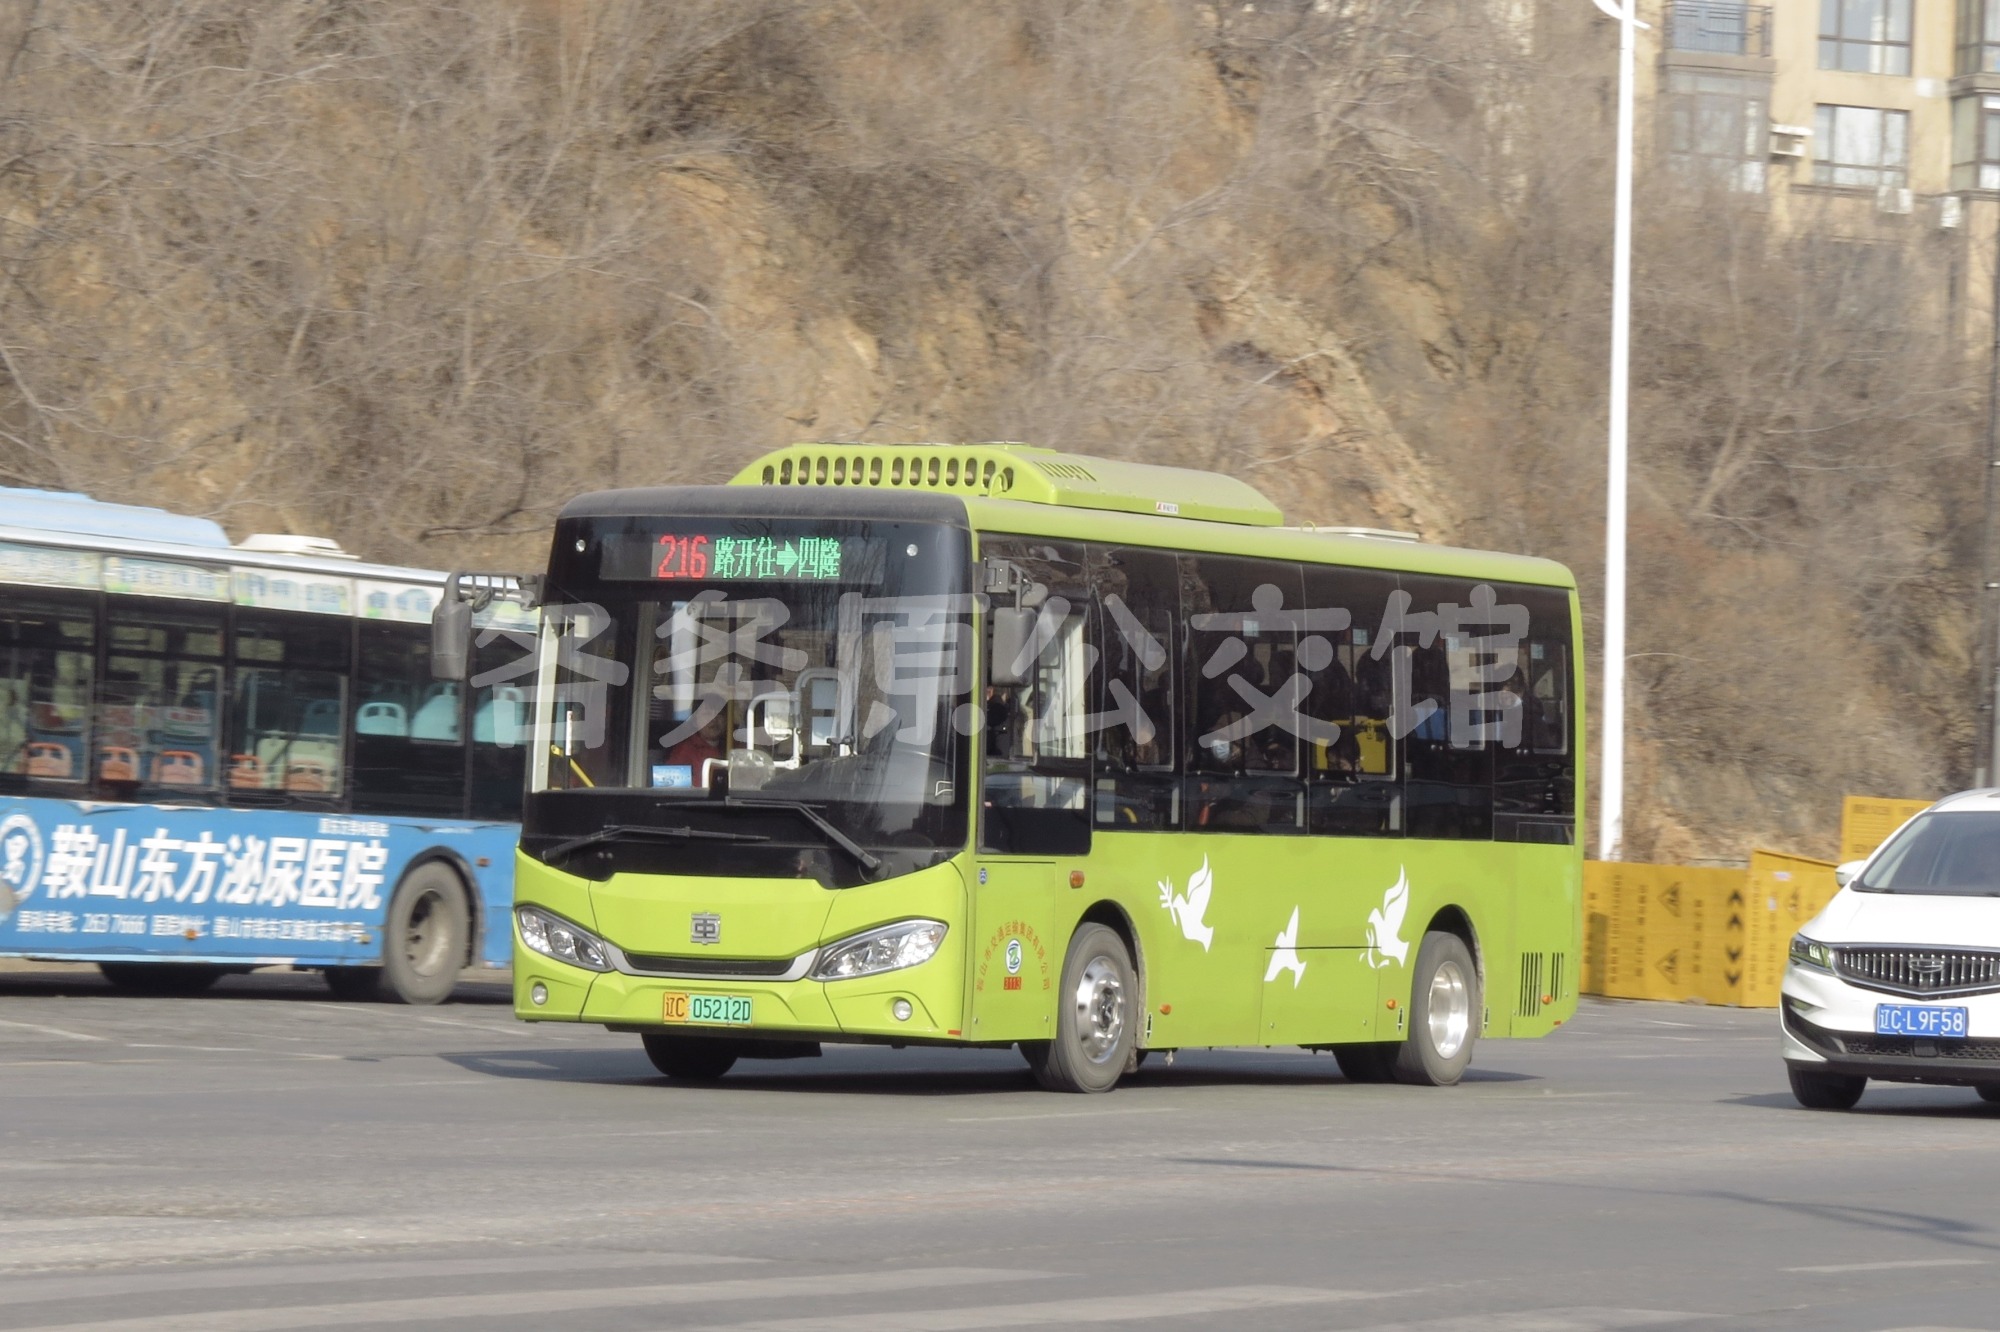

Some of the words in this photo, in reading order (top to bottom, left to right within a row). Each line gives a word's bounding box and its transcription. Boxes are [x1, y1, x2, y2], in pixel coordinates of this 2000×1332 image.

[657, 535, 708, 579] 216
[42, 823, 389, 910] 鞍山东方泌尿医院
